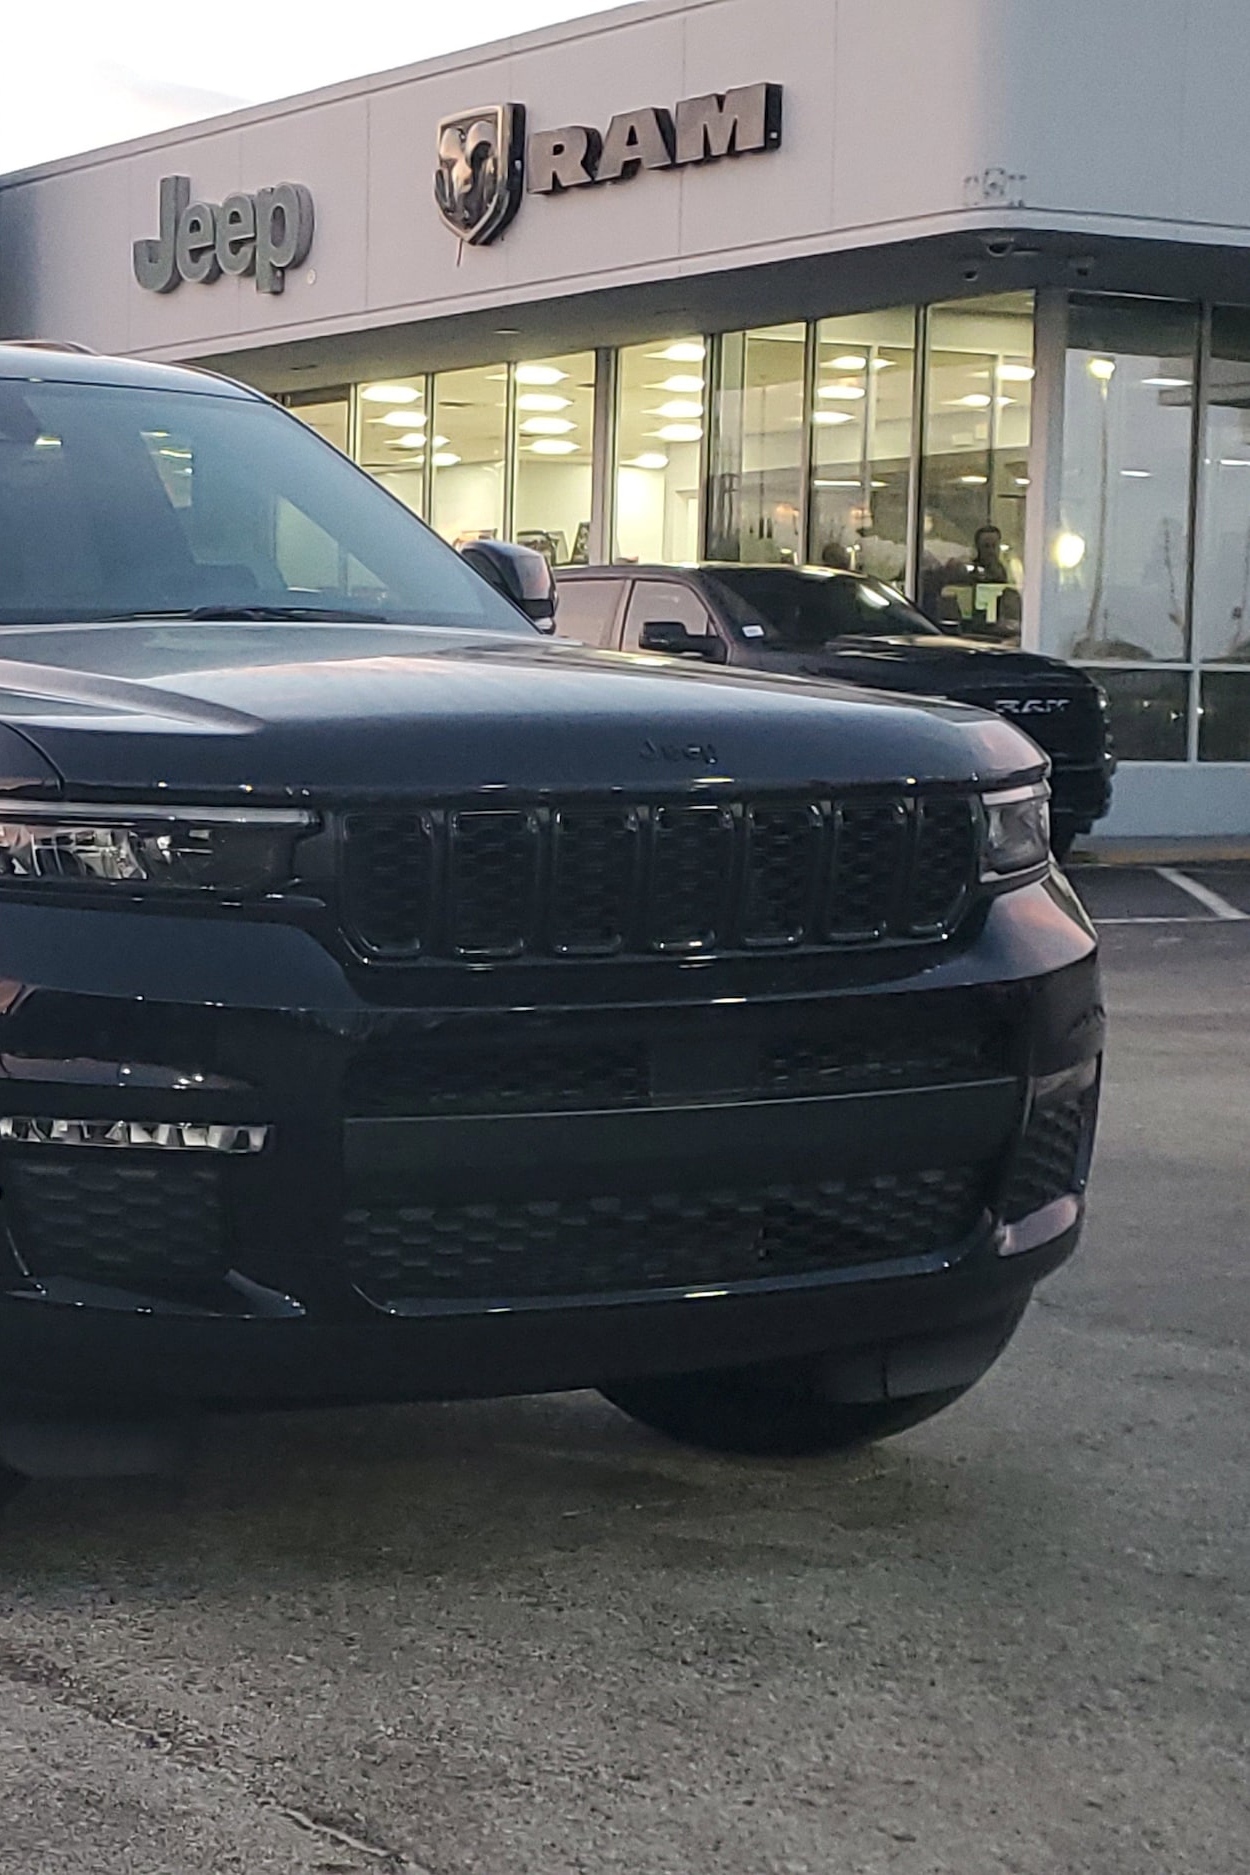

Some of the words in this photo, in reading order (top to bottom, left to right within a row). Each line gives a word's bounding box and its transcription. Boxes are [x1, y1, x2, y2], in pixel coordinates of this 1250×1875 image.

[527, 83, 781, 194] RAM
[133, 175, 314, 294] Jeep
[994, 698, 1071, 714] RAM
